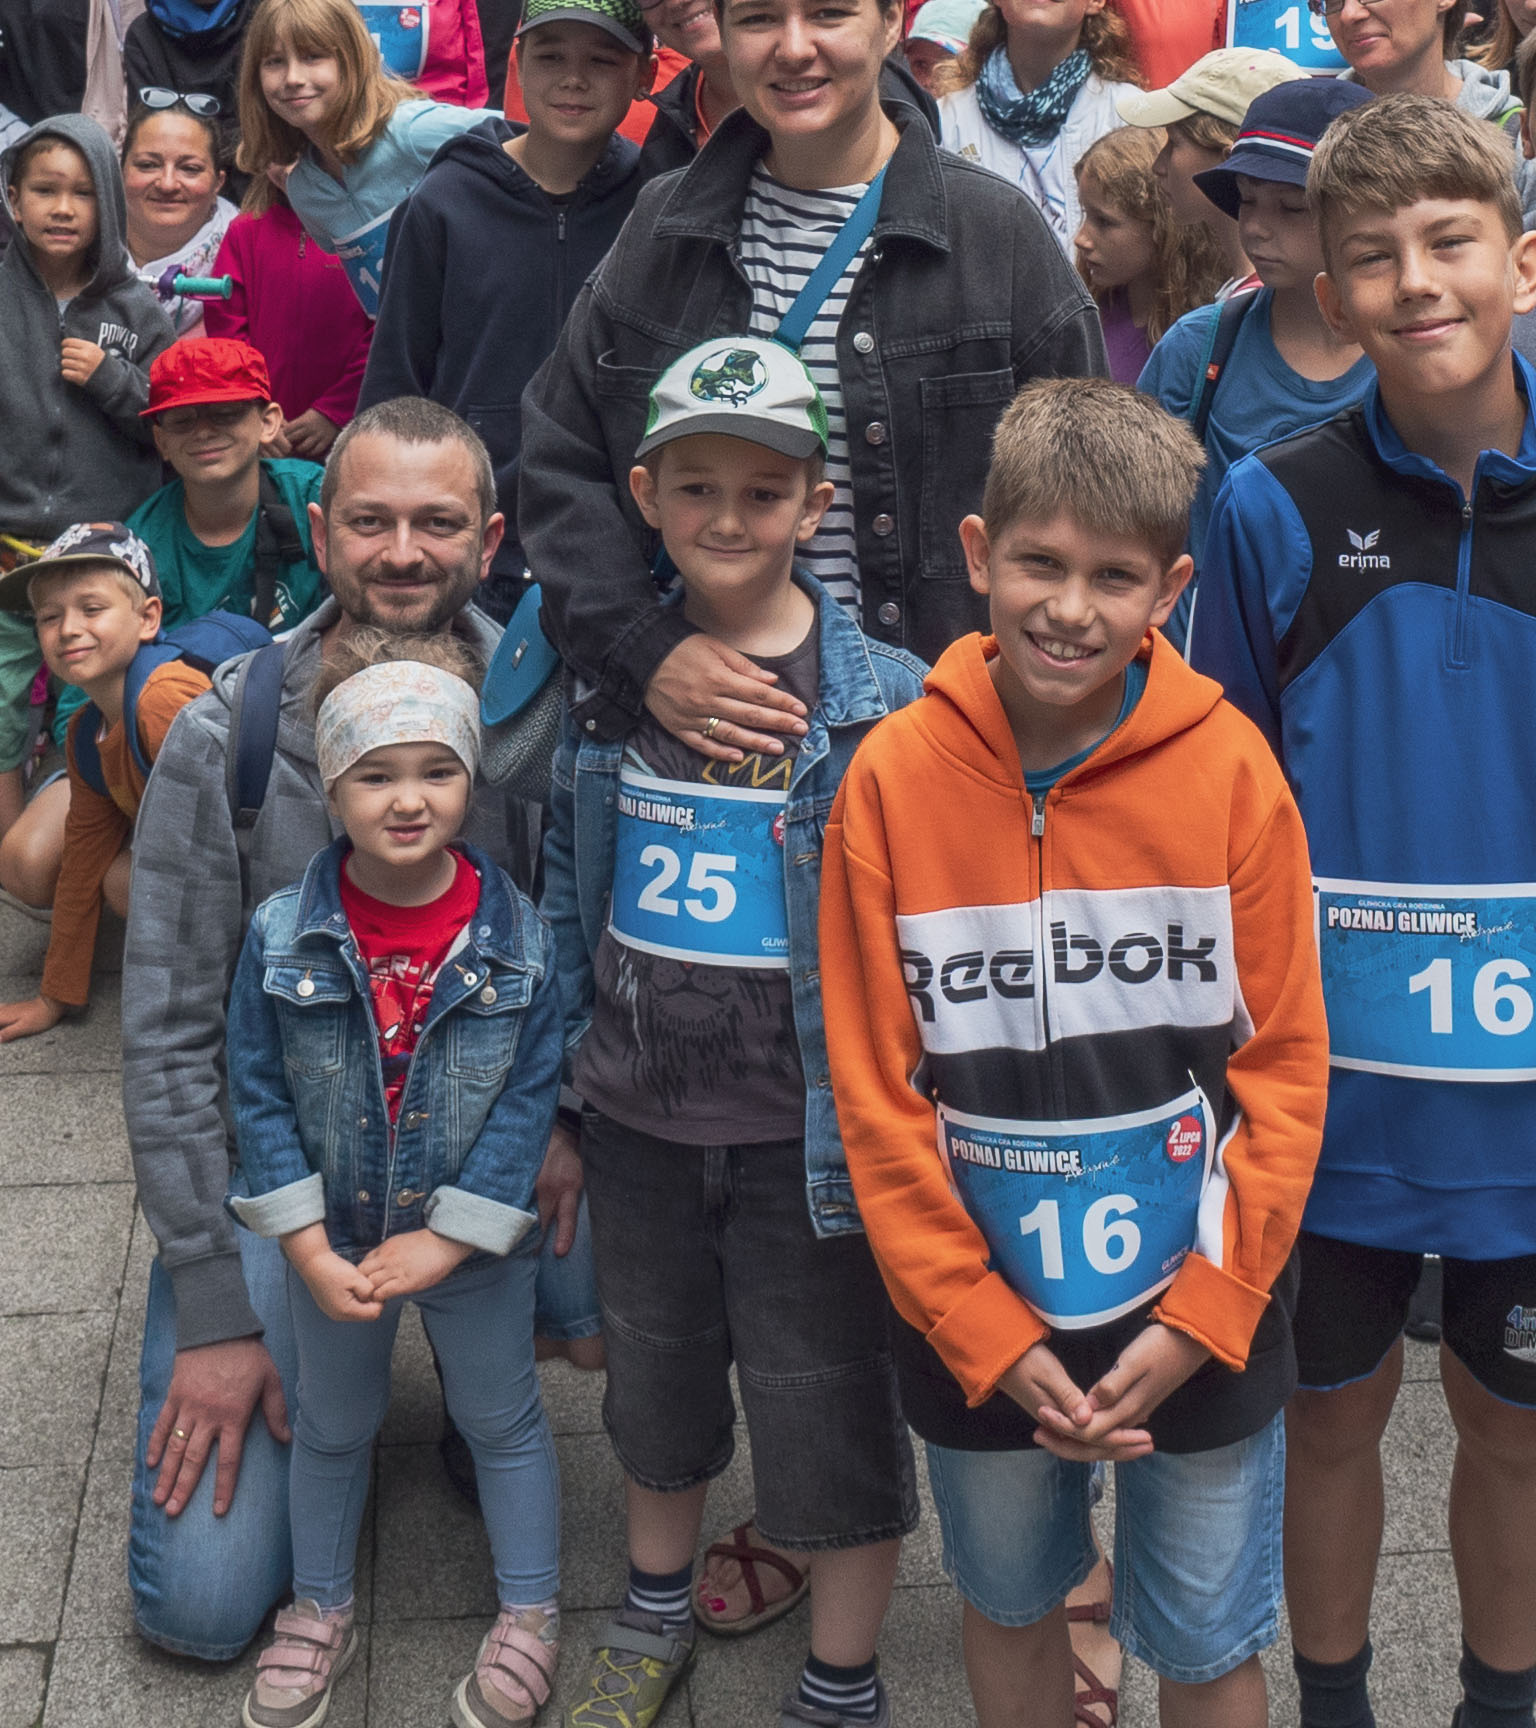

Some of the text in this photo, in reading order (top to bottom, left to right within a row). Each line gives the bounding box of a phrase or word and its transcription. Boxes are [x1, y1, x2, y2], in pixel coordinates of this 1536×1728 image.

[1275, 6, 1340, 51] 19
[1338, 552, 1391, 569] erima
[618, 794, 695, 826] ZNAJ GLIWICE
[637, 843, 737, 923] 25
[1328, 906, 1477, 934] POZNAJ GLIWICE
[901, 920, 1218, 1022] Reebok
[1408, 958, 1534, 1036] 16
[1167, 1121, 1202, 1144] 2 LIPCA
[1172, 1143, 1193, 1156] 2022
[951, 1136, 1081, 1174] POZNAJ GLIWICE
[1019, 1193, 1142, 1280] 16
